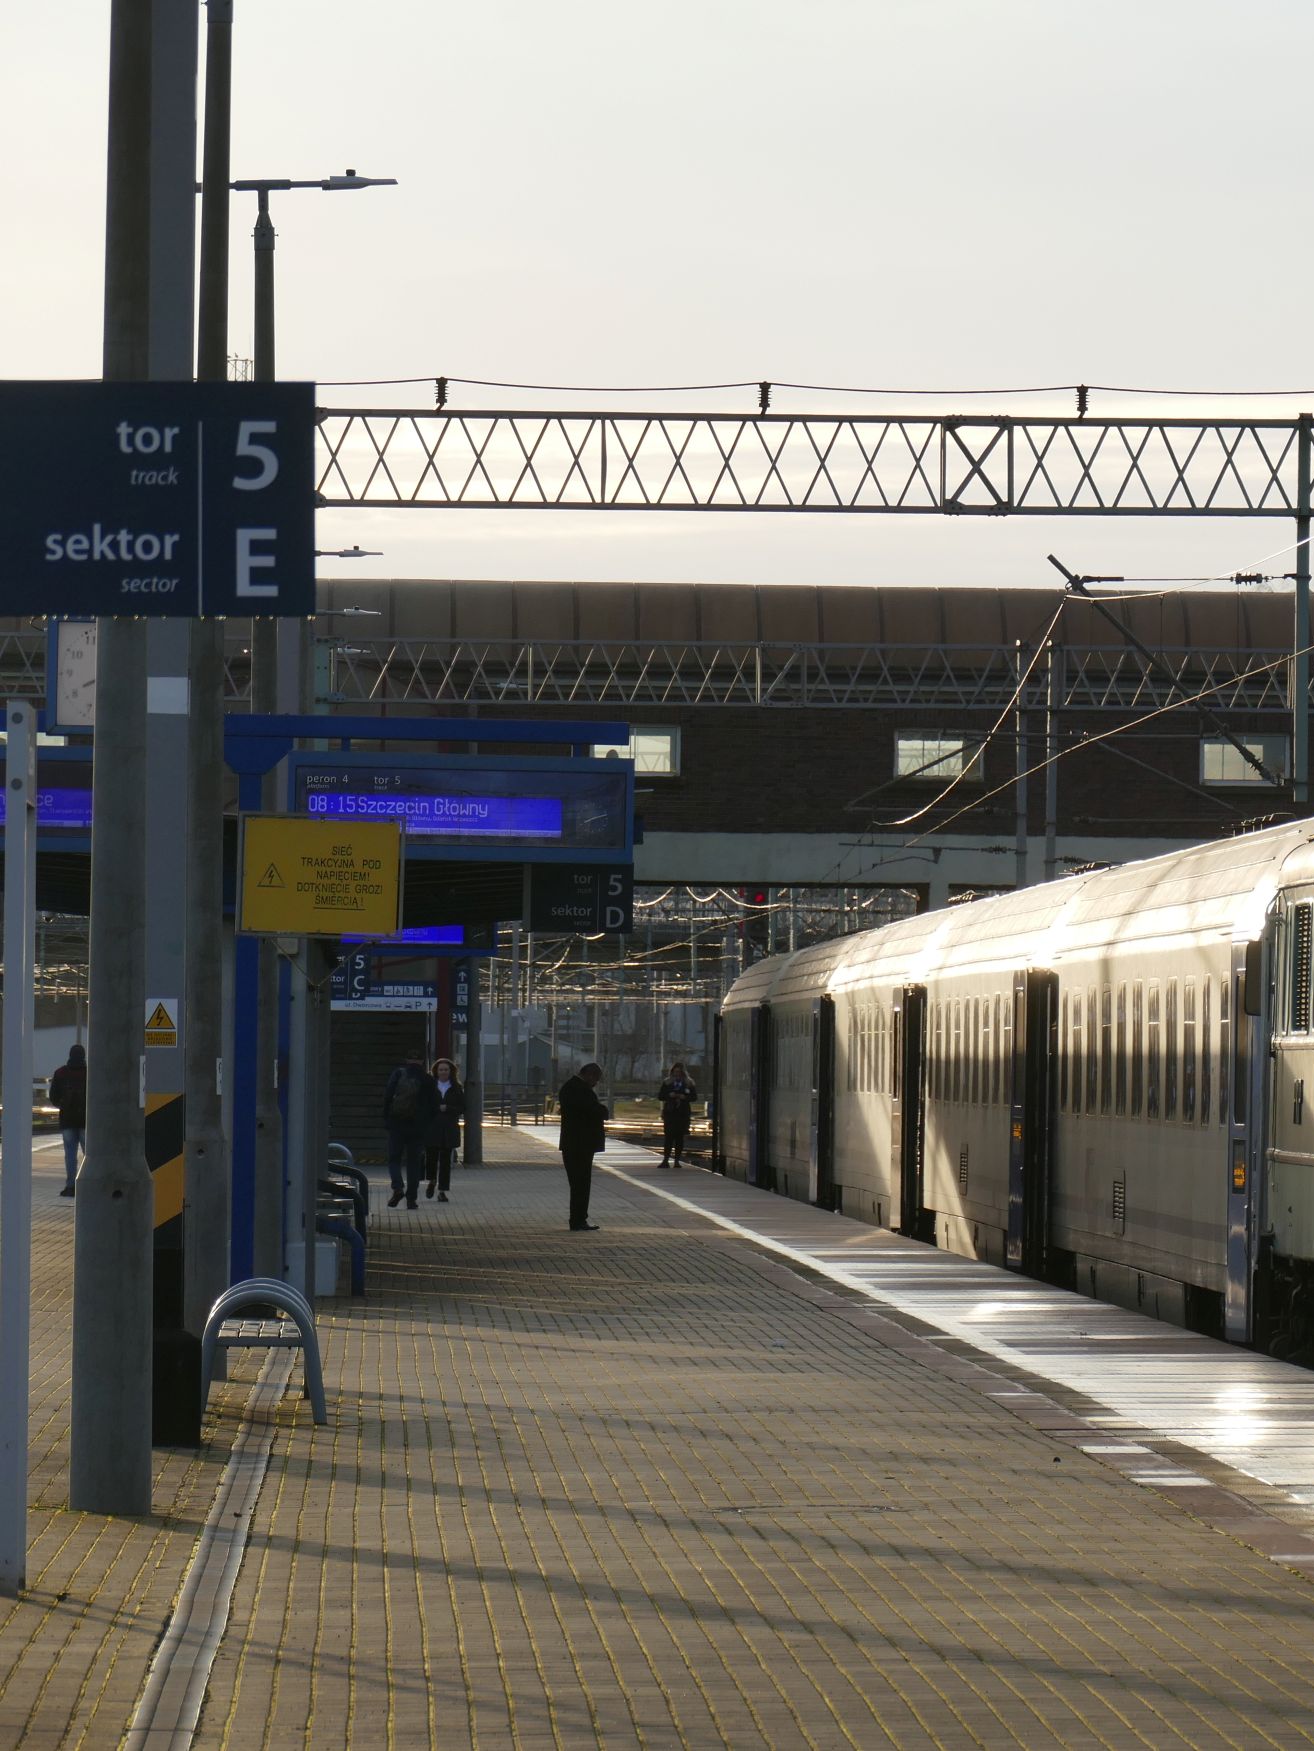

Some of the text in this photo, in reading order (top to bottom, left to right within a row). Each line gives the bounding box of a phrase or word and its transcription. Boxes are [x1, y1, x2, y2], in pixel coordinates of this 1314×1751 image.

[116, 420, 279, 491] tor 5
[130, 466, 179, 486] track
[45, 523, 279, 597] sektor E
[121, 576, 179, 593] sector
[306, 774, 401, 785] peron 4 tor 5
[357, 796, 429, 815] Szczecin
[434, 797, 489, 817] Główny
[331, 844, 353, 857] SIEĆ
[301, 856, 382, 870] TRAKCYJNA POD
[316, 870, 370, 883] NAPIĘCIEM!
[355, 883, 383, 895] GROZI
[573, 874, 593, 884] tor
[607, 874, 623, 896] 5
[551, 904, 593, 917] sektor
[605, 906, 625, 928] D
[354, 955, 365, 969] 5
[353, 975, 365, 990] C
